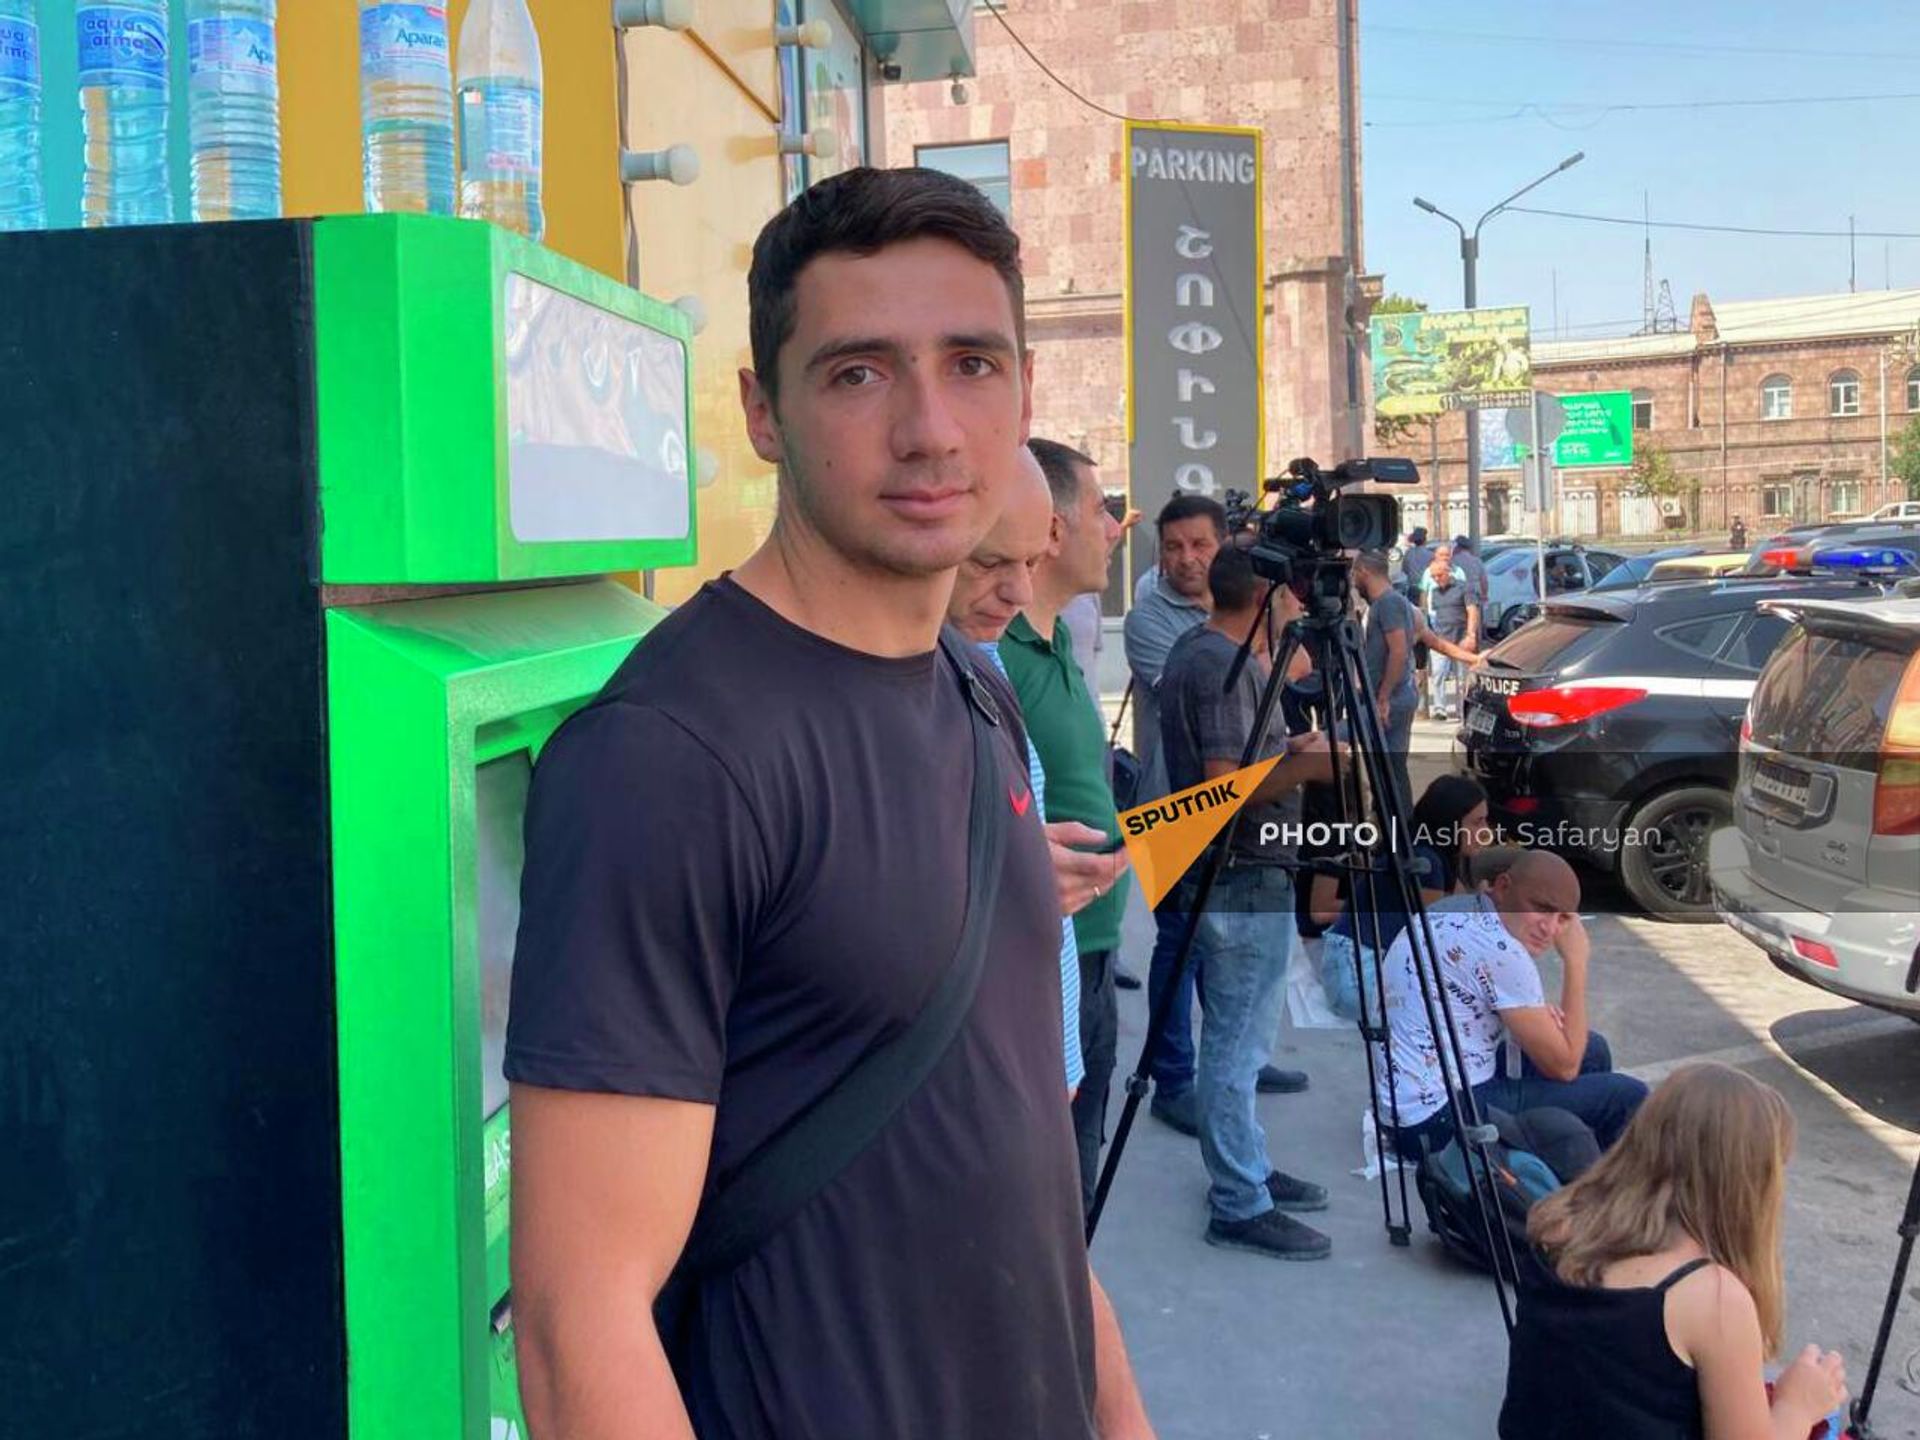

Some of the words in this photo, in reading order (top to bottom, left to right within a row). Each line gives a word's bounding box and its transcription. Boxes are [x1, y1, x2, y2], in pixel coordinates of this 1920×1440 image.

[86, 20, 134, 34] aqua
[1131, 147, 1256, 184] PARKING
[1480, 675, 1520, 697] POLICE
